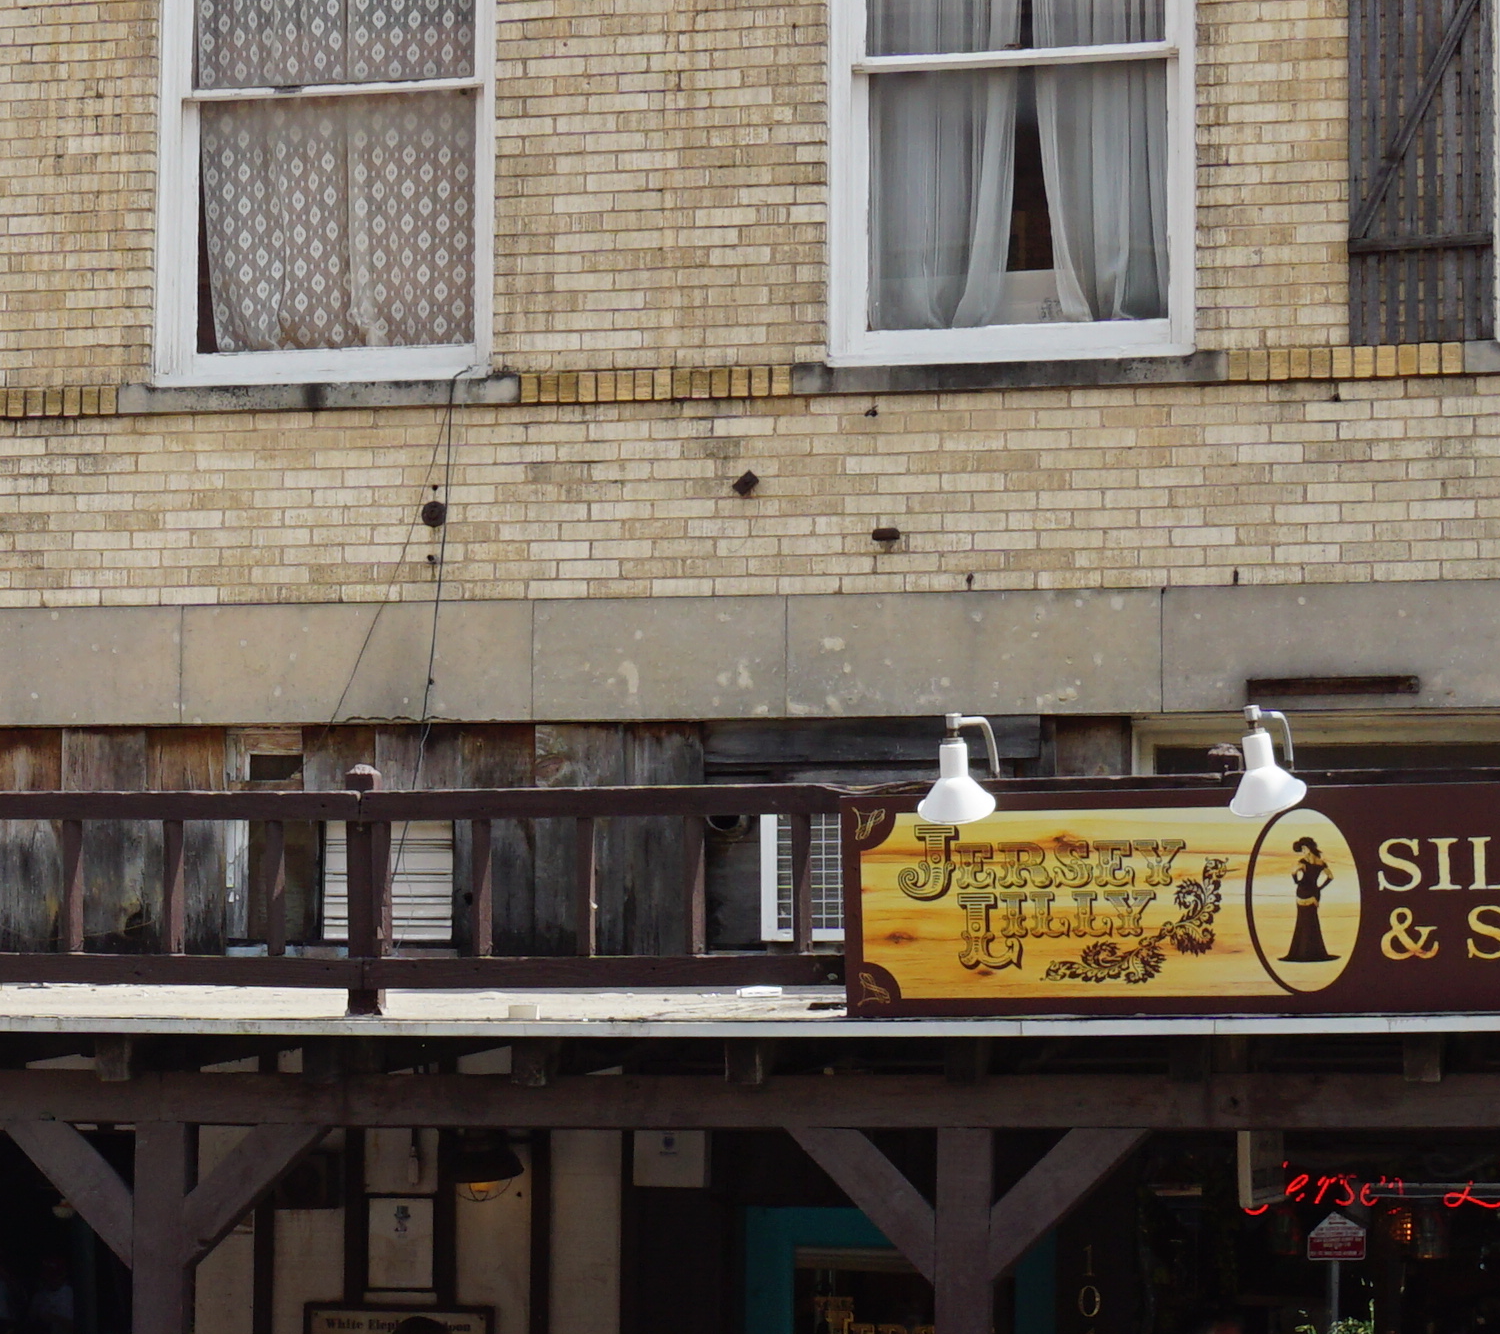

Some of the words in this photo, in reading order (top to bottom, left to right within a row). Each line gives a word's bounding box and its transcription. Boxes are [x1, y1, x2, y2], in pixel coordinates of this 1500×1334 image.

[898, 823, 1186, 901] JERSEY
[957, 887, 1157, 972] LILLY
[1379, 908, 1439, 960] &
[326, 1318, 363, 1329] White
